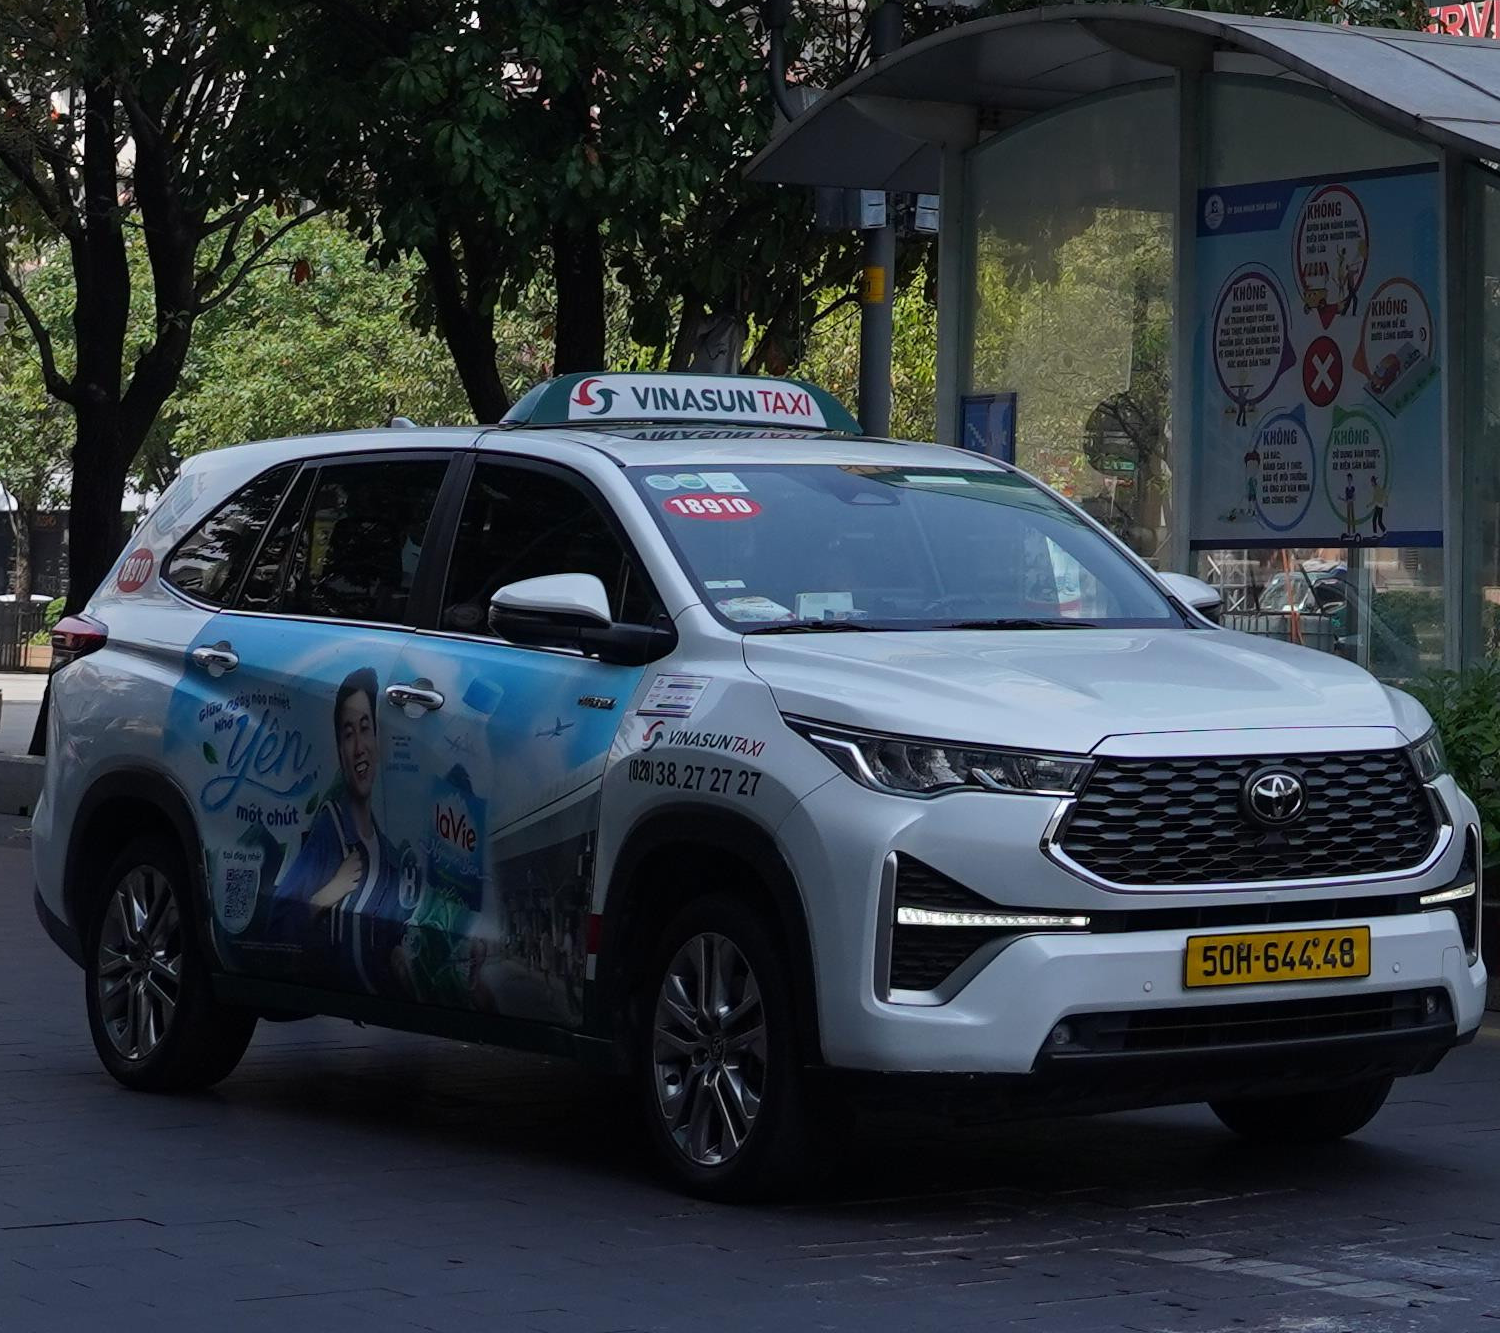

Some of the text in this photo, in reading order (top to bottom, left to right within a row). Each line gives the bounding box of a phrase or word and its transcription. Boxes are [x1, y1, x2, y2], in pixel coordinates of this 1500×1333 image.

[1307, 200, 1342, 220] KHÔNG
[1233, 283, 1266, 301] KHÔNG
[1371, 297, 1407, 316] KHÔNG
[1263, 427, 1297, 446] KHÔNG
[1334, 427, 1369, 445] KHÔNG
[670, 497, 753, 515] 18910
[118, 557, 152, 583] 18910
[709, 767, 733, 794] 27
[737, 770, 762, 797] 27
[236, 803, 299, 826] một chút
[1202, 937, 1355, 977] 50H-644.48
